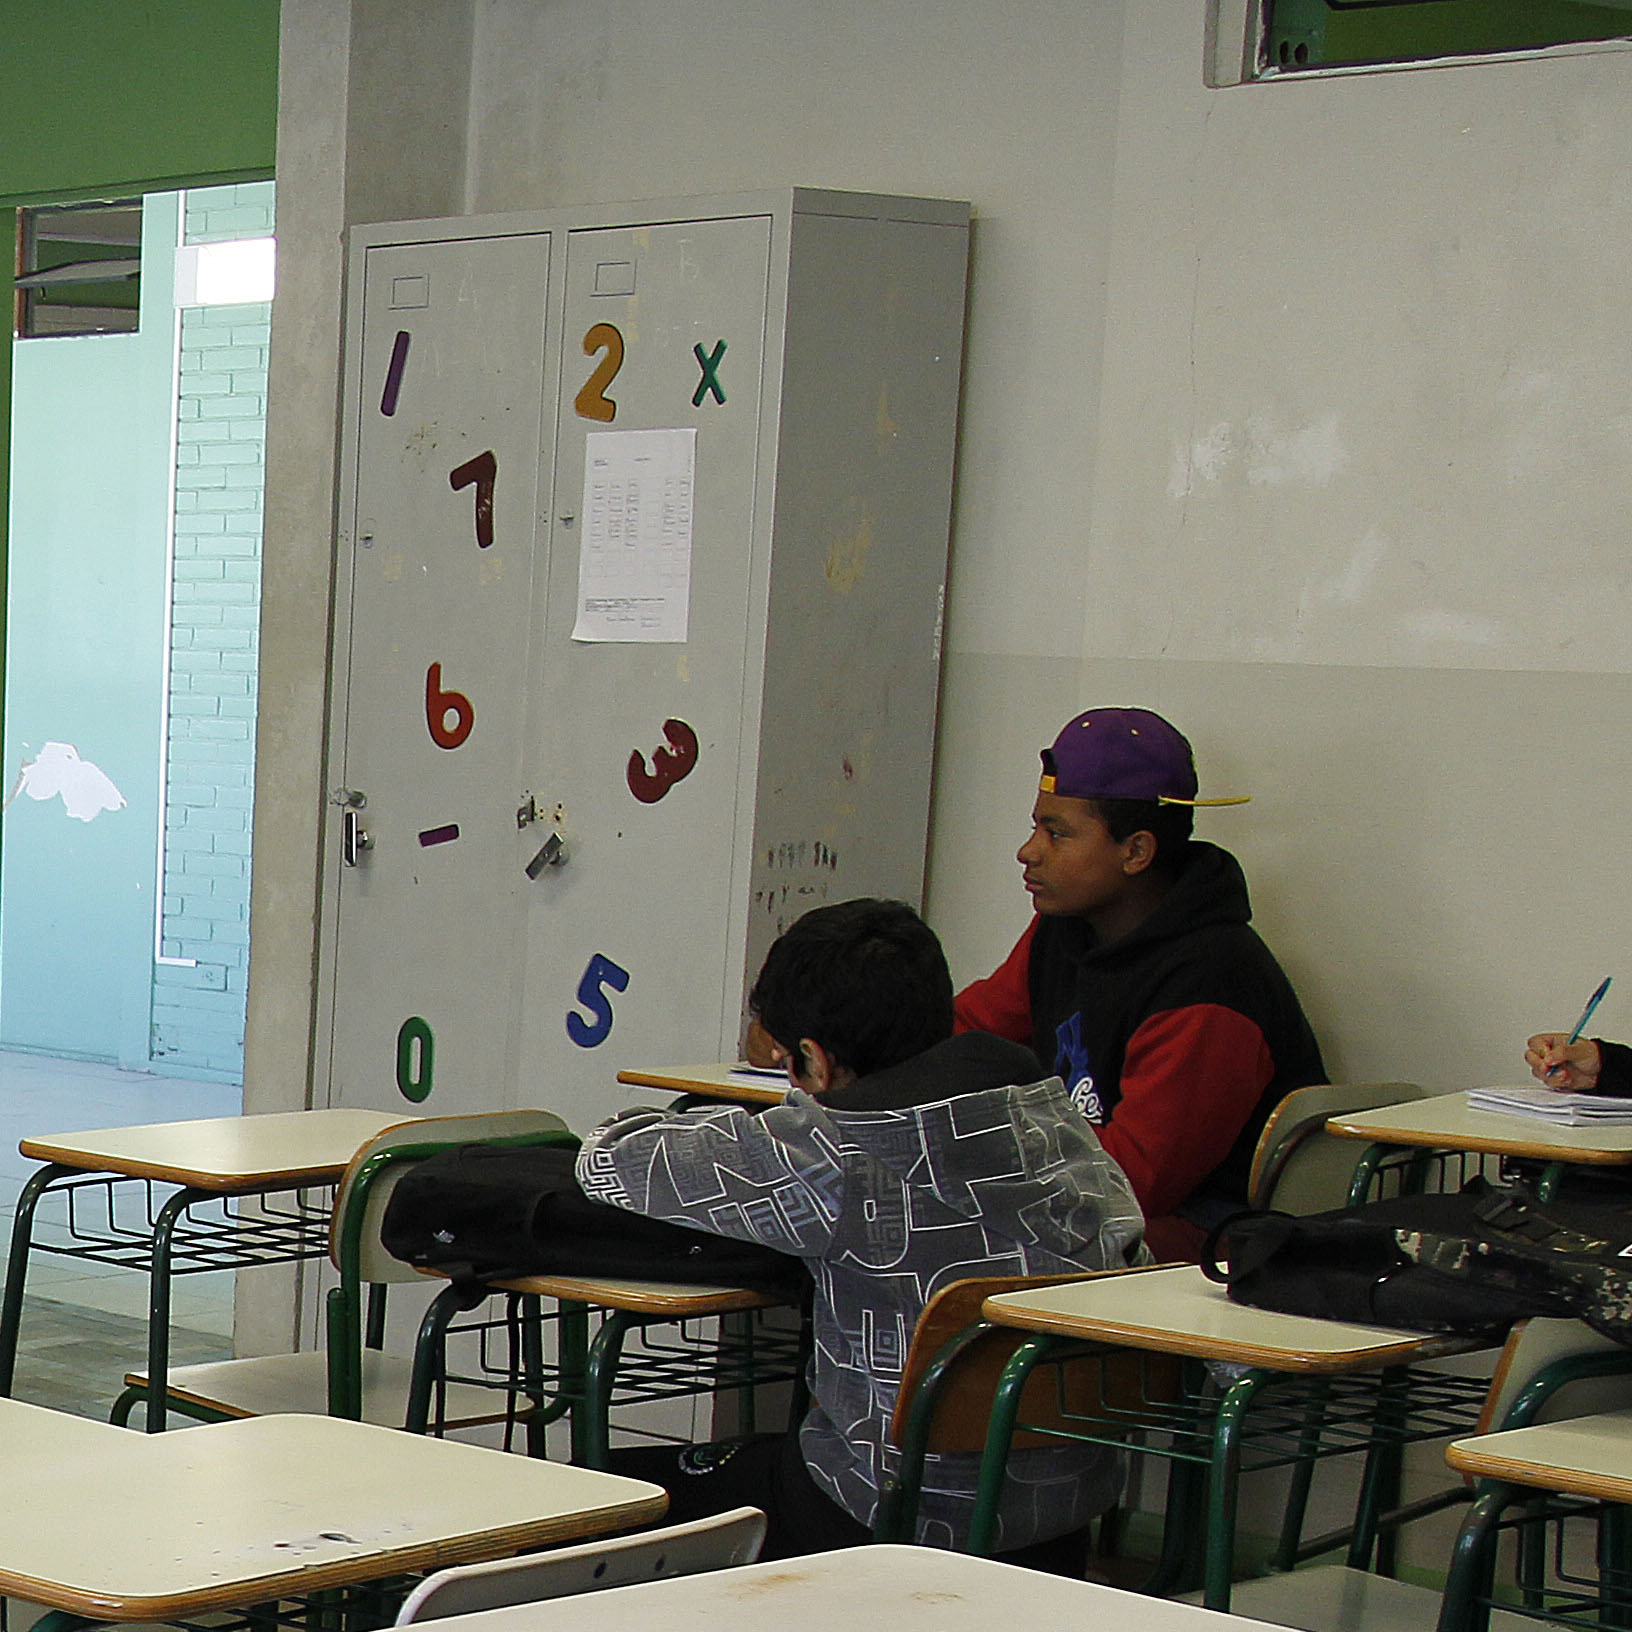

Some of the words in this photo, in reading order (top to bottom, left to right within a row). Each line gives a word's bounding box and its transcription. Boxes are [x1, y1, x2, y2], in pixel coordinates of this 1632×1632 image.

[574, 322, 624, 423] 2
[450, 449, 497, 549] 7
[425, 661, 474, 750] 6
[628, 717, 698, 804] 3
[566, 953, 629, 1048] 5
